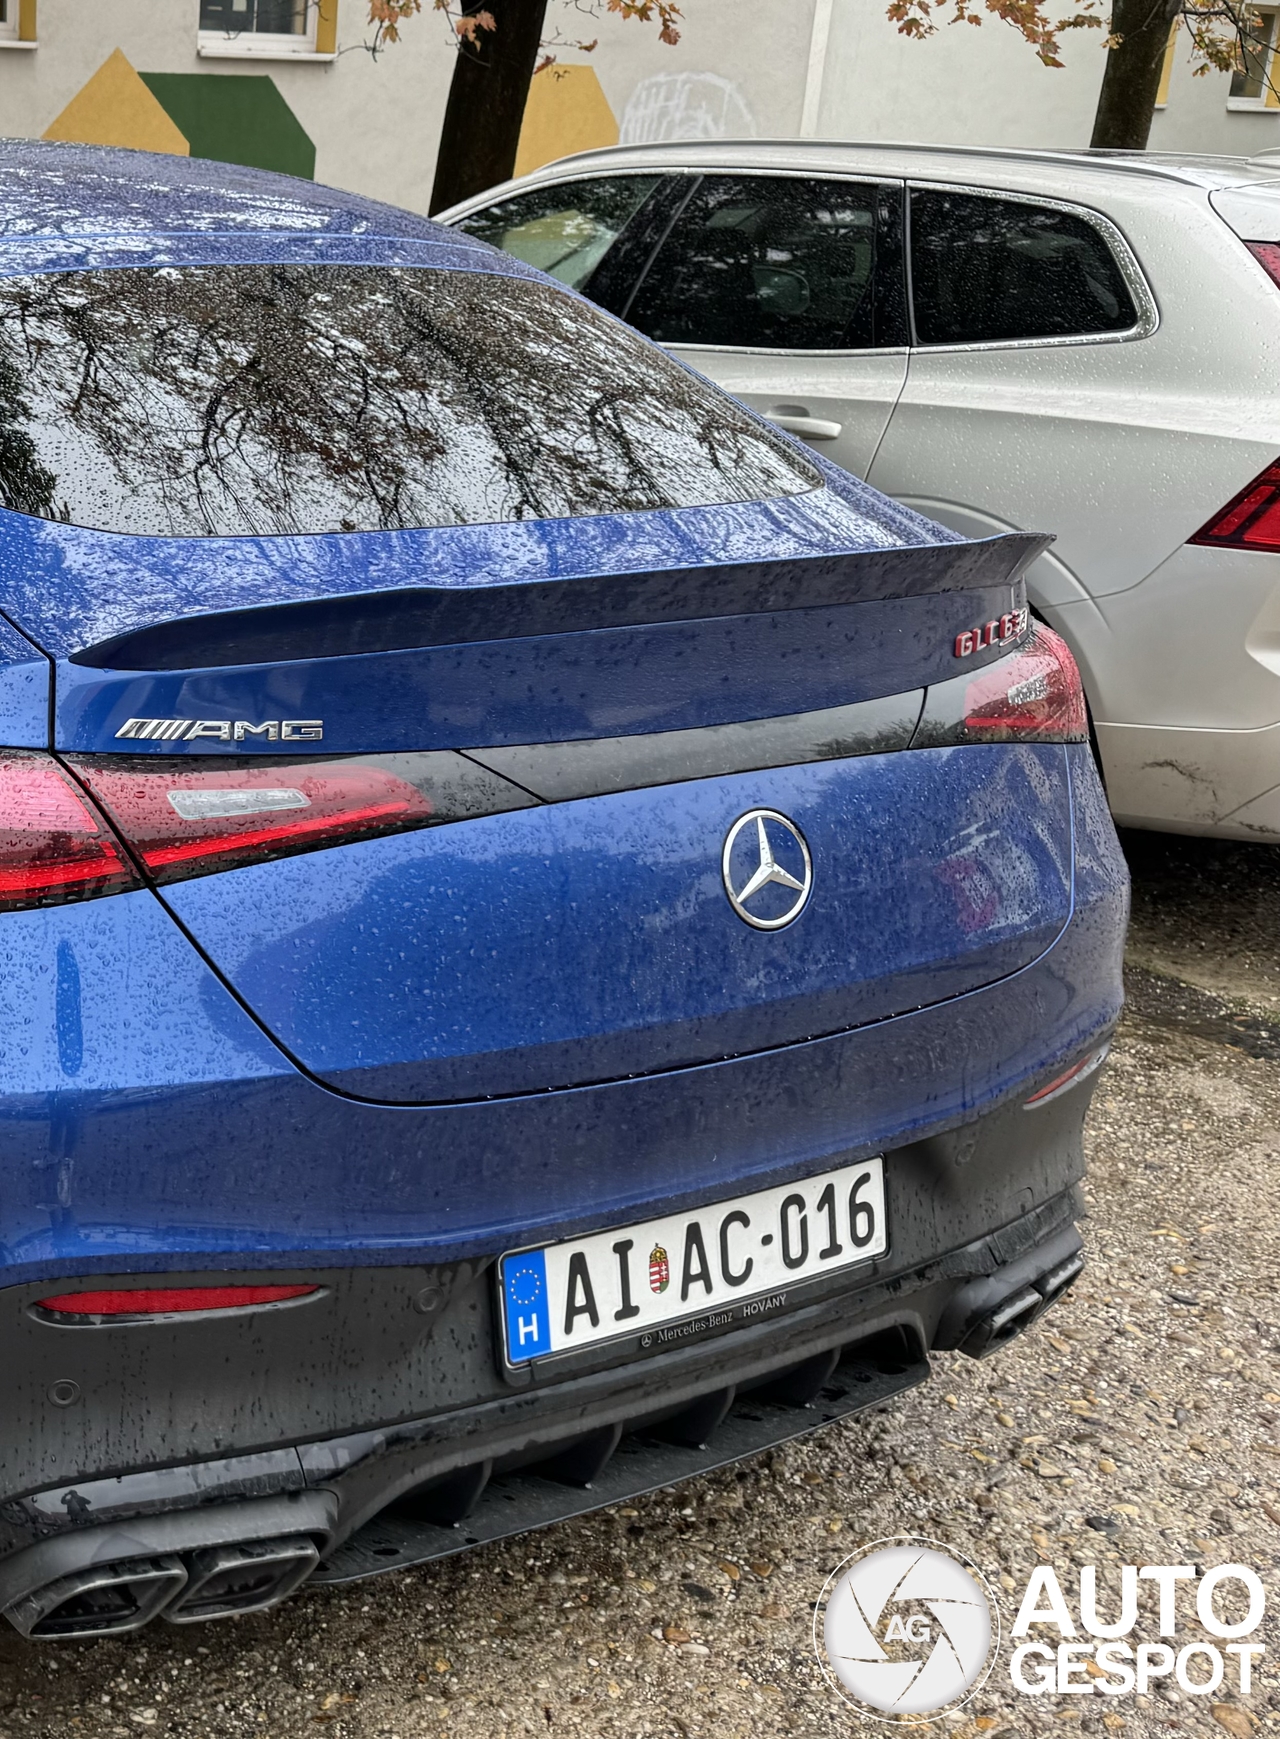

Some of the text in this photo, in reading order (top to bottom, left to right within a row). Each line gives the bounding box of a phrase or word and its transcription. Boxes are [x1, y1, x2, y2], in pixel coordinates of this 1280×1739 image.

[518, 1312, 539, 1346] H
[657, 1292, 787, 1344] Mercedes-Benz HOVÁNY
